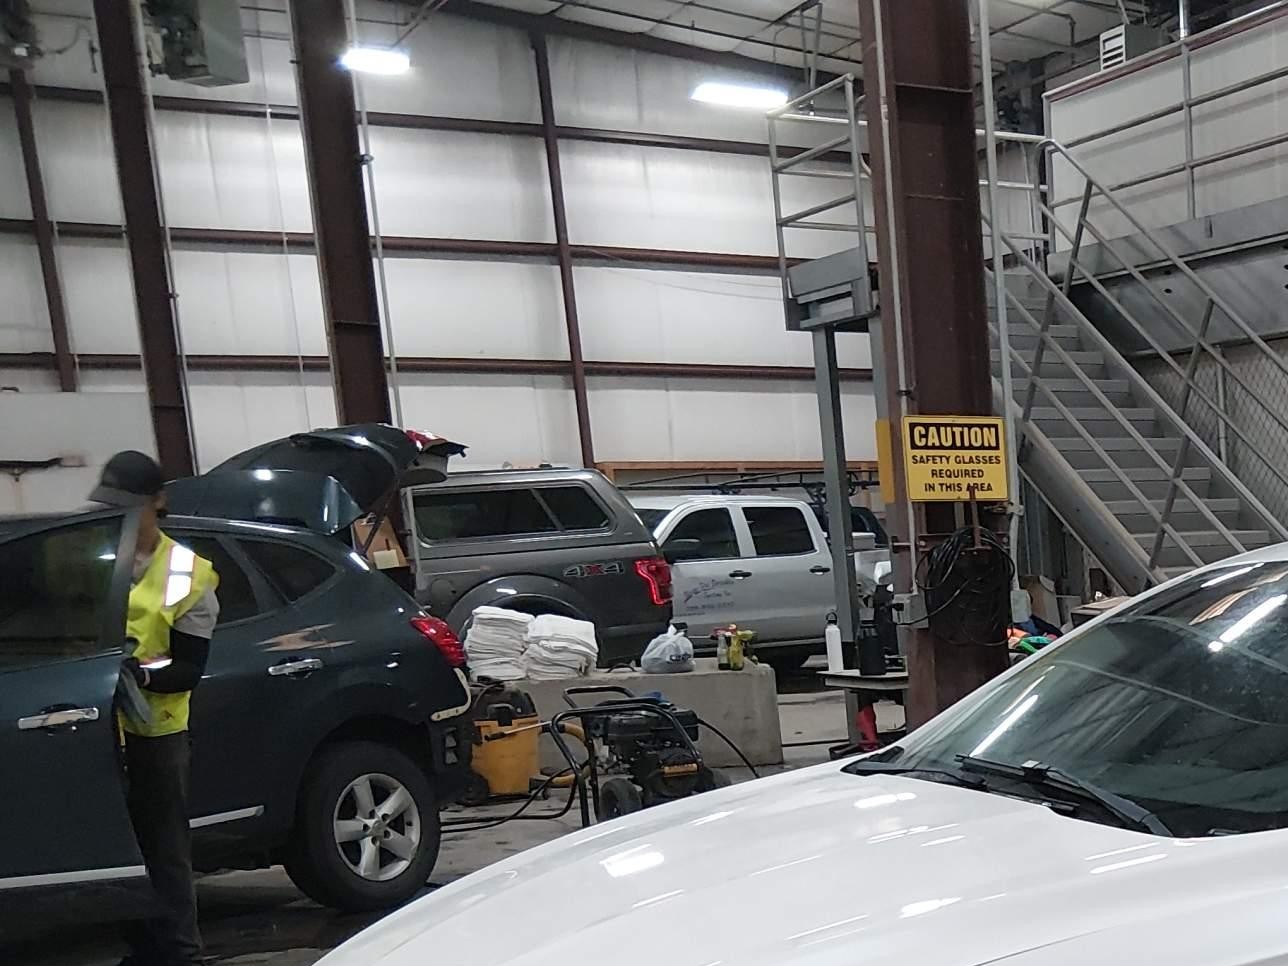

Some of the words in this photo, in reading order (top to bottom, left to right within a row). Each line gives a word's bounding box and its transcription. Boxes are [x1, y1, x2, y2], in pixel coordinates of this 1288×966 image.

[913, 425, 997, 447] CAUTION
[911, 455, 951, 465] SAFETY
[954, 455, 1001, 465] GLASSES
[931, 469, 985, 479] REQUIRED
[924, 482, 936, 492] IN
[938, 482, 963, 492] THIS
[966, 482, 993, 492] AREA
